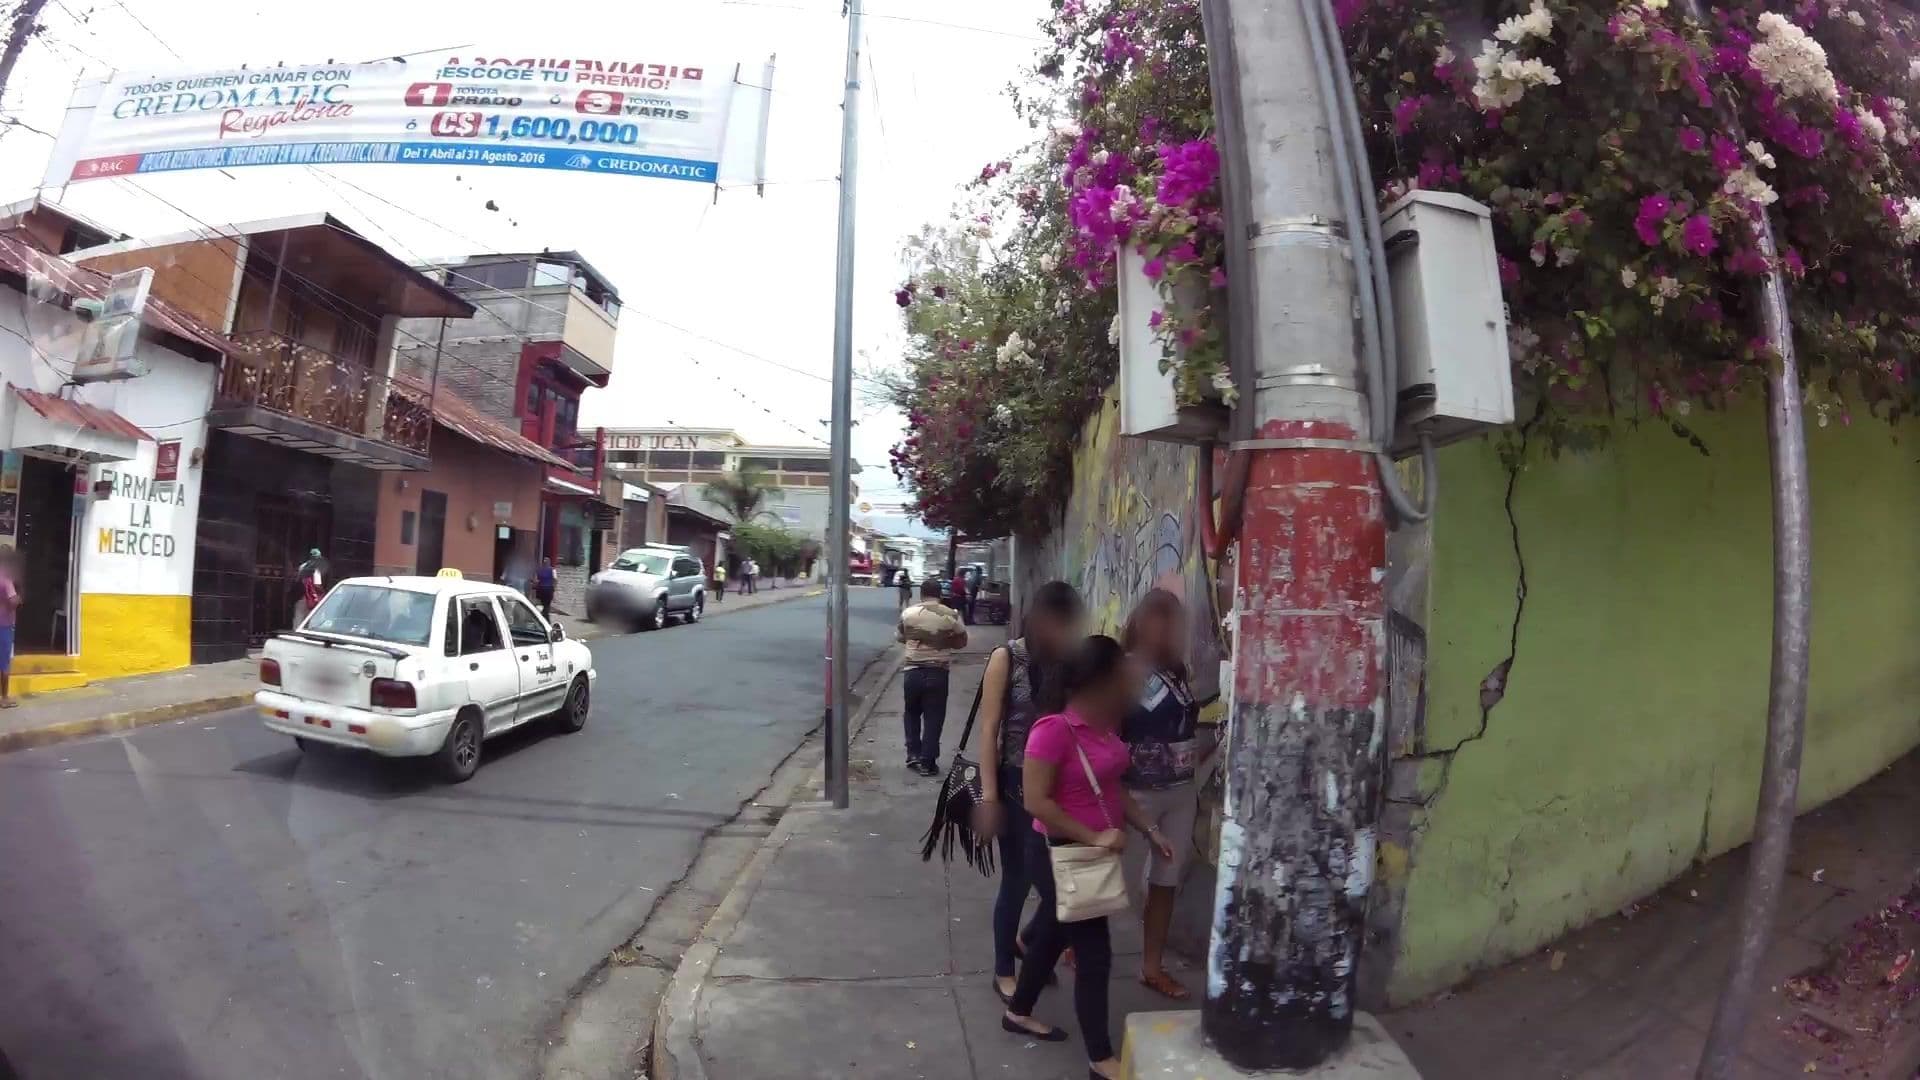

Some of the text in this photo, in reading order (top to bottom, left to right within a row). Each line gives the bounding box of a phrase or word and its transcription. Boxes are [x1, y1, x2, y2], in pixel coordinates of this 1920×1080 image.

[125, 70, 351, 96] TODOS QUIEREN GANAR CON
[436, 67, 671, 90] ¡ESCOGE TU PREMIO!
[455, 86, 498, 95] TOYOTA
[113, 83, 349, 119] CREDOMATIC
[450, 96, 523, 106] PRADO
[628, 97, 672, 107] TOYOTA
[625, 105, 690, 120] YARIS
[437, 112, 476, 136] C$
[484, 114, 639, 145] 1,600,000
[403, 148, 420, 160] Del
[429, 149, 455, 160] Abril
[456, 151, 466, 161] al
[467, 152, 480, 161] 31
[481, 152, 518, 164] Agosto
[519, 153, 546, 164] 2016
[597, 158, 707, 178] CREDOMATIC
[648, 435, 699, 449] UCAN
[130, 503, 152, 529] LA
[98, 527, 175, 557] MERCED
